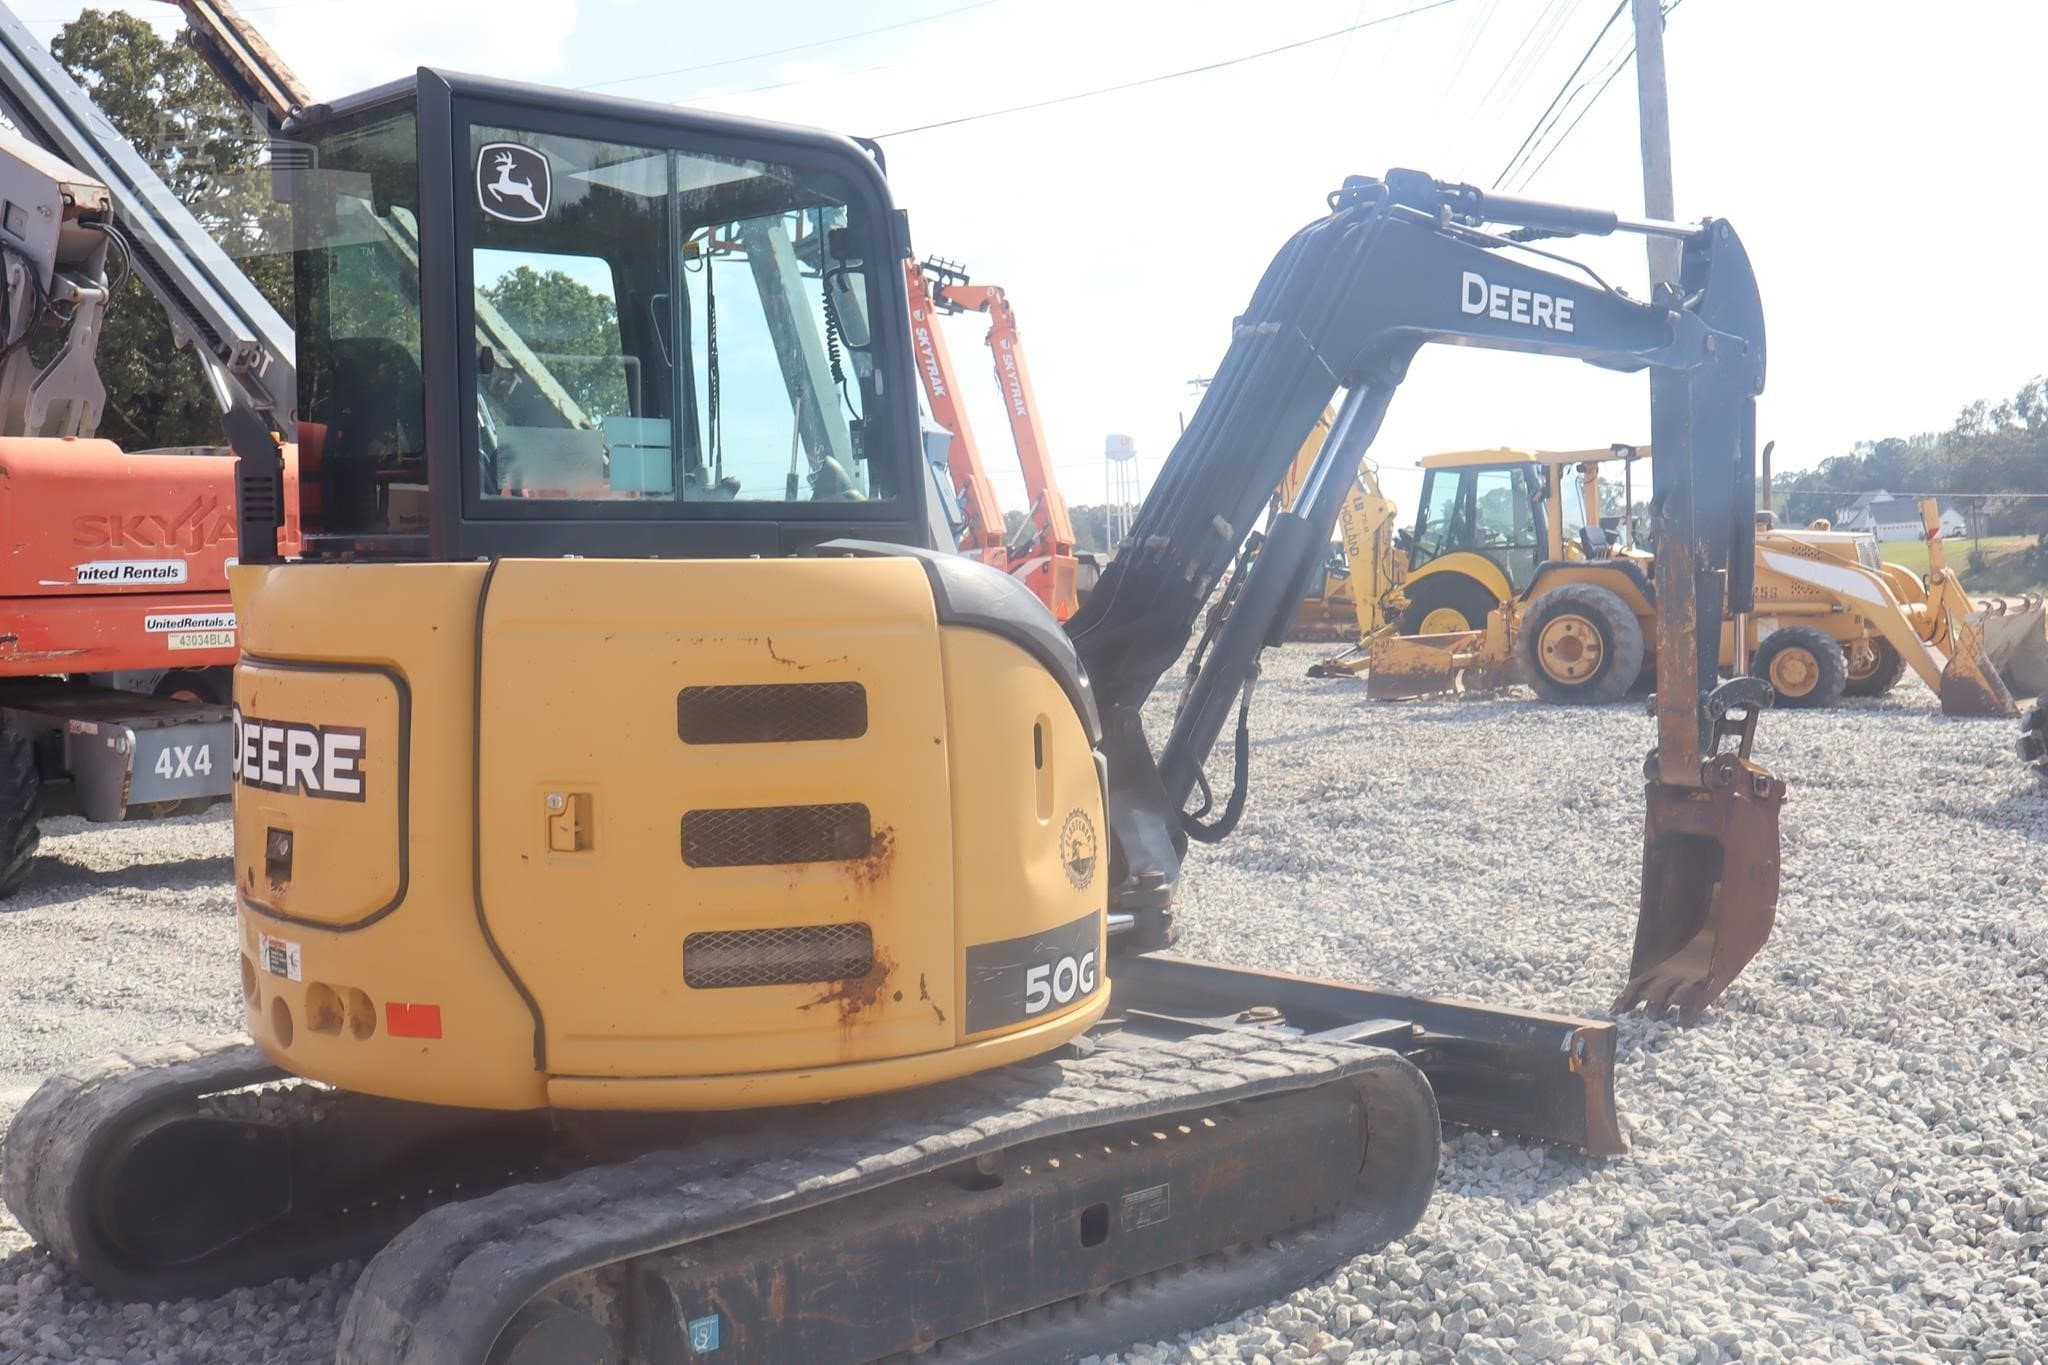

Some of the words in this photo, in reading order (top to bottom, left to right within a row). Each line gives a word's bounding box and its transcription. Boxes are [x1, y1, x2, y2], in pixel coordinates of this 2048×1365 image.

[1461, 271, 1575, 332] DEERE
[916, 327, 946, 397] SKYTRAK
[1002, 353, 1027, 416] SKYTRAK
[72, 495, 239, 556] SKYJA
[77, 568, 119, 580] nited
[123, 566, 178, 579] Rentals
[147, 617, 237, 630] UnitedRentals.c
[180, 633, 231, 646] 43034BLA
[155, 744, 212, 779] 4X4
[232, 707, 361, 794] DEERE
[1025, 951, 1095, 1014] 50G
